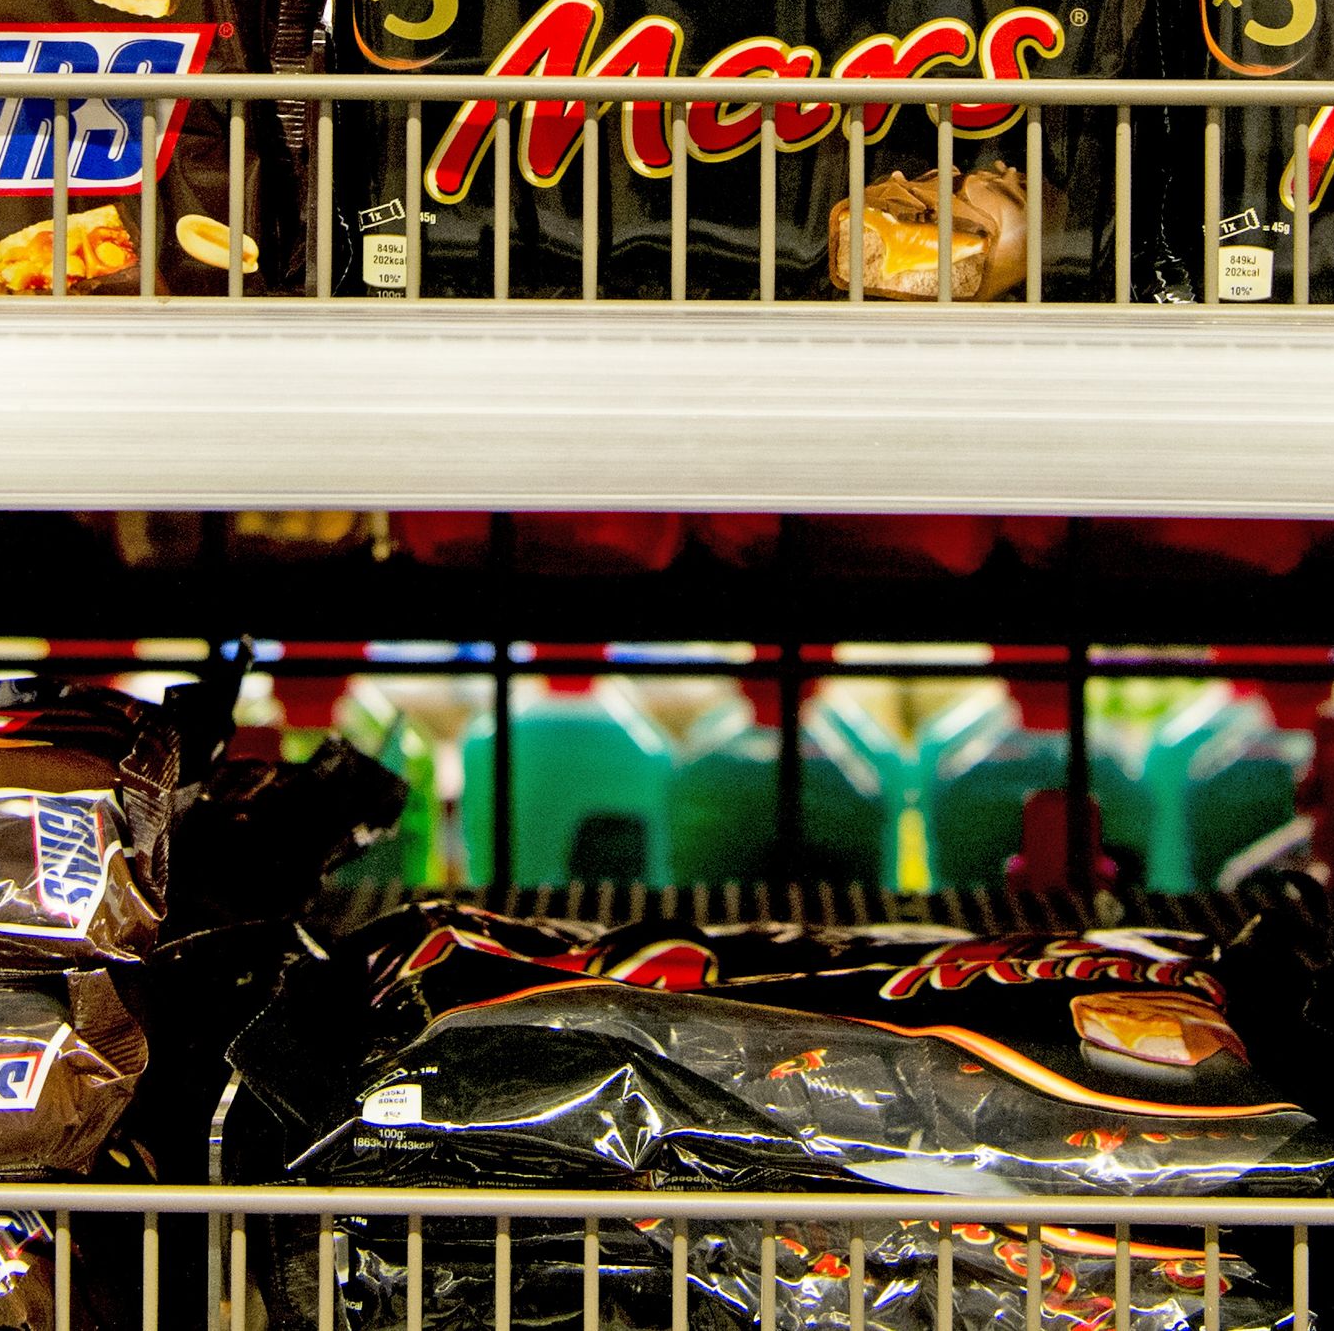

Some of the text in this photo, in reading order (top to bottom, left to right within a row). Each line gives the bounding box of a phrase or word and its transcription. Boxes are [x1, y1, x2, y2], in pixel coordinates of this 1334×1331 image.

[1271, 222, 1291, 235] 45g
[1230, 255, 1257, 265] 849kJ
[1225, 267, 1260, 277] 202kcal
[378, 1128, 407, 1140] 100g:
[394, 1141, 435, 1151] 443kcal
